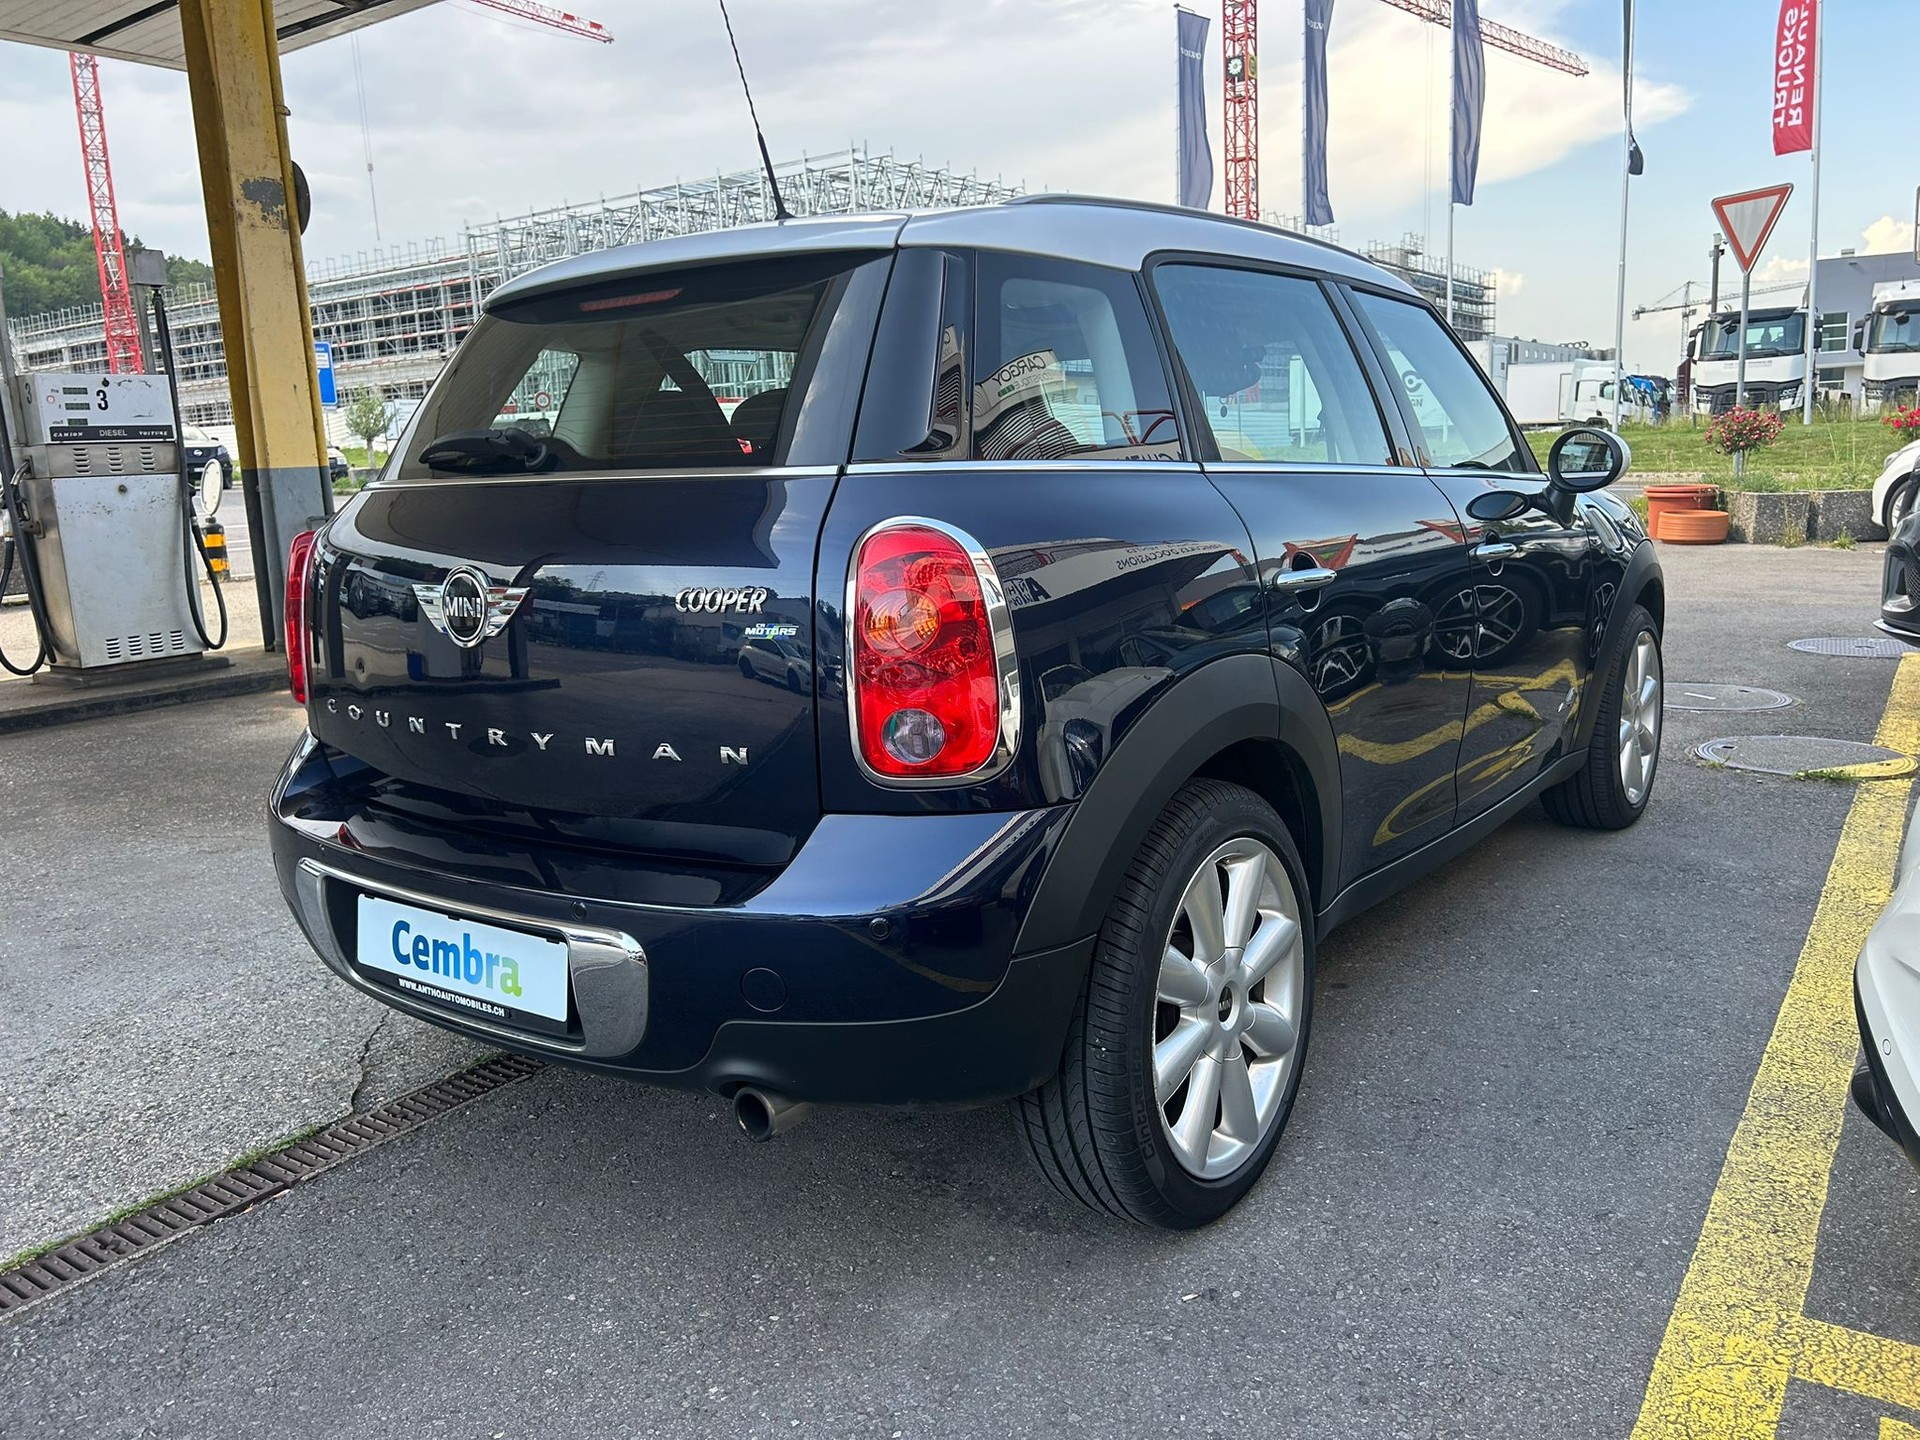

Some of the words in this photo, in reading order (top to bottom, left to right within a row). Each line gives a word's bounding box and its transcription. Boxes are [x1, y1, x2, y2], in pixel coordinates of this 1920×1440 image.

[1306, 18, 1326, 30] VOLV
[1180, 47, 1202, 60] VOLVO
[25, 382, 33, 404] 3
[96, 389, 109, 410] 3
[99, 429, 128, 437] DIESEL
[446, 596, 481, 618] MINI
[674, 586, 768, 615] COOPER
[744, 627, 797, 636] MOTORS
[326, 698, 750, 766] COUNTRYMAN
[391, 919, 523, 998] Cembra
[398, 978, 505, 1018] WWW.ANTHOAUTOMOBILES.CH
